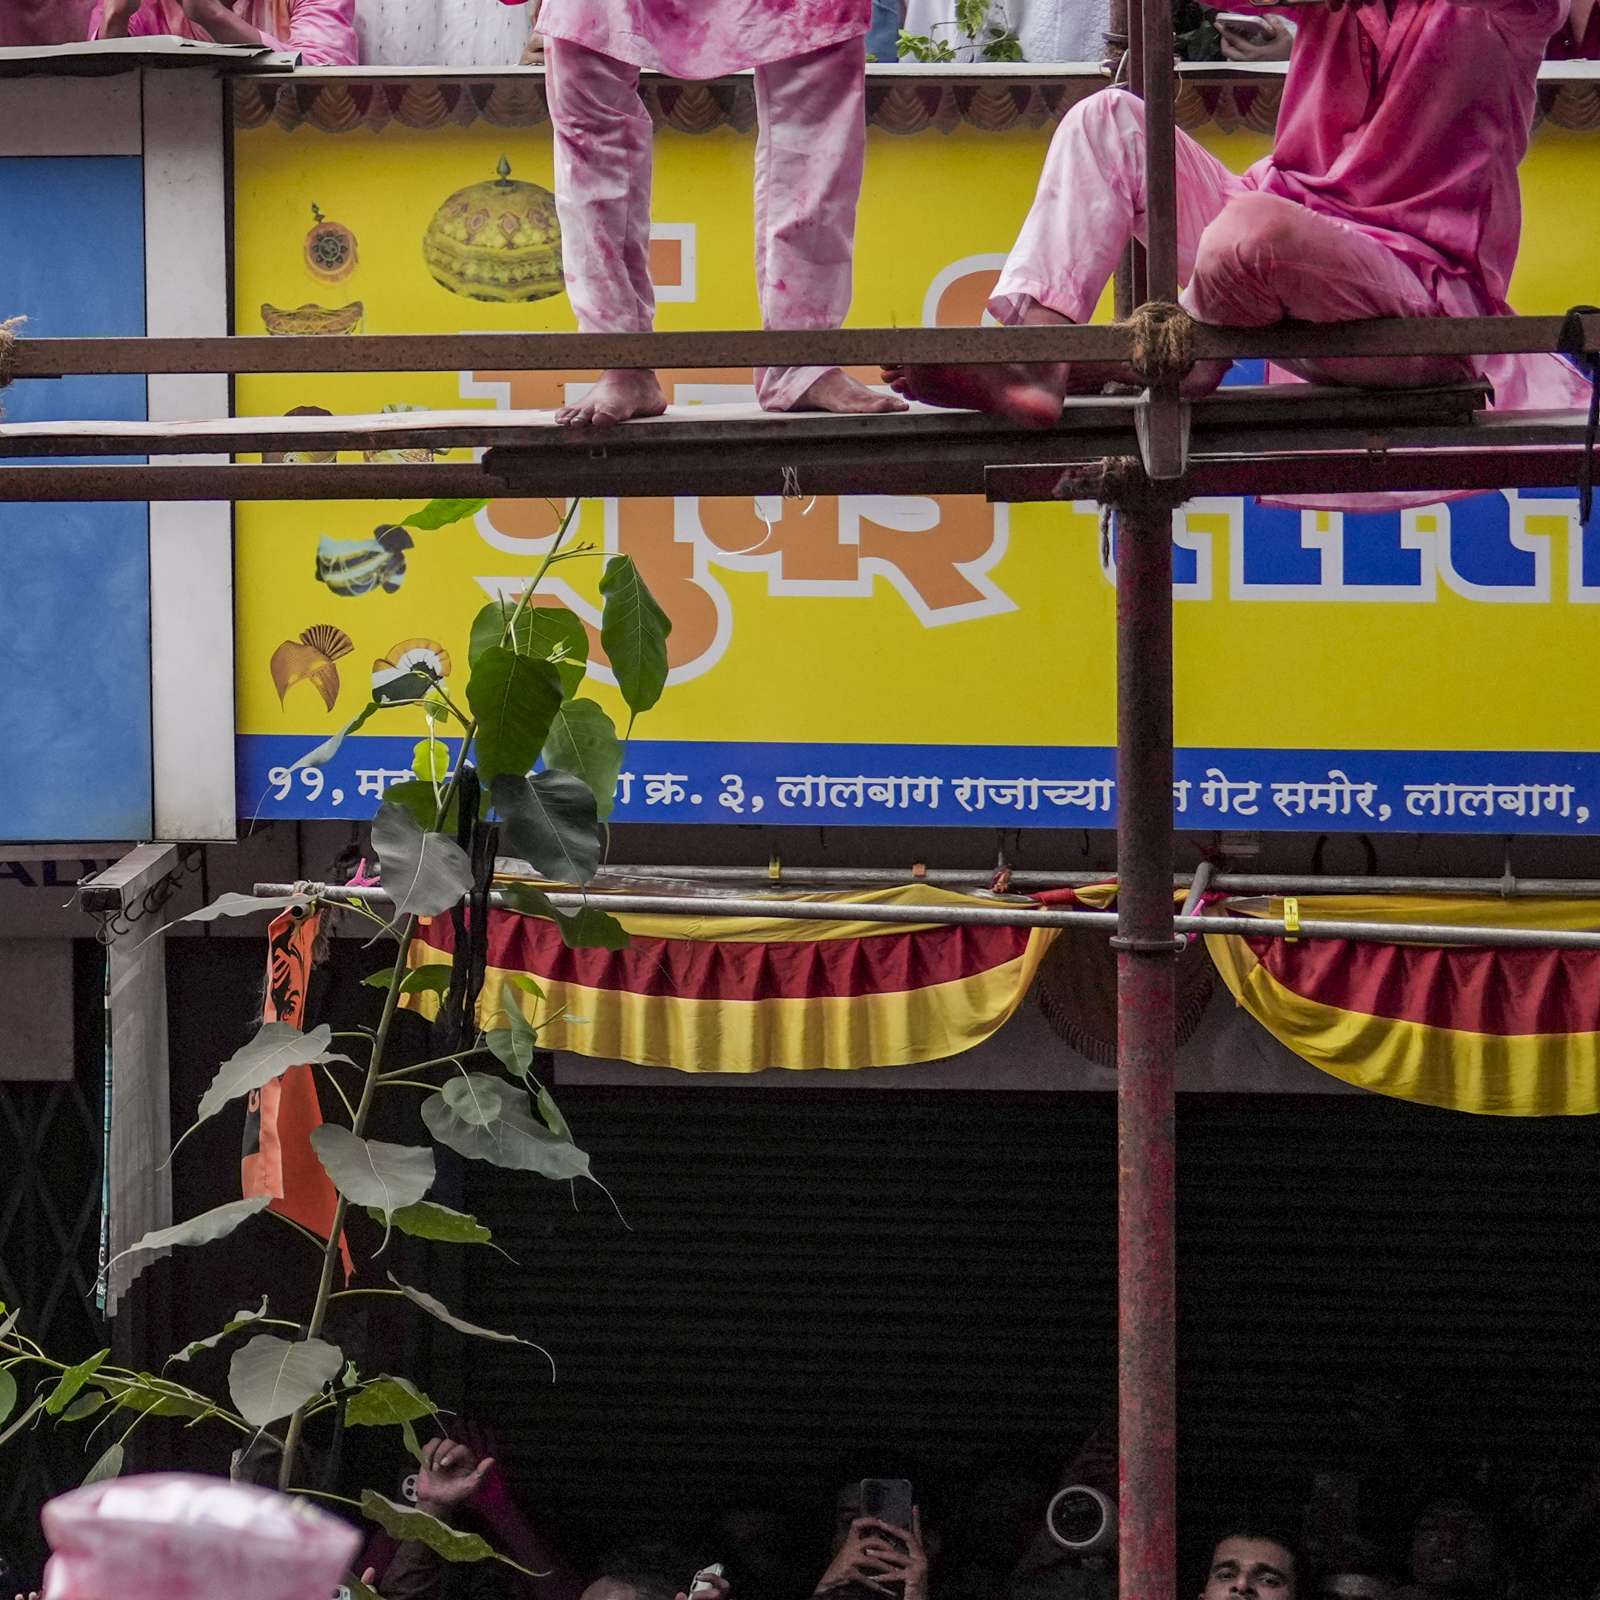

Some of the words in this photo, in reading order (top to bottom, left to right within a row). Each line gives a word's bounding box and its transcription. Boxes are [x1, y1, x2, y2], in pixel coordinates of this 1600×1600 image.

[643, 773, 703, 806] क्र.
[719, 774, 764, 813] ३,
[776, 775, 943, 808] लालबाग
[951, 777, 1115, 812] राजाच्या
[1200, 768, 1262, 815] गेट
[1271, 769, 1392, 821] समोर,
[1404, 783, 1590, 824] लालबाग,
